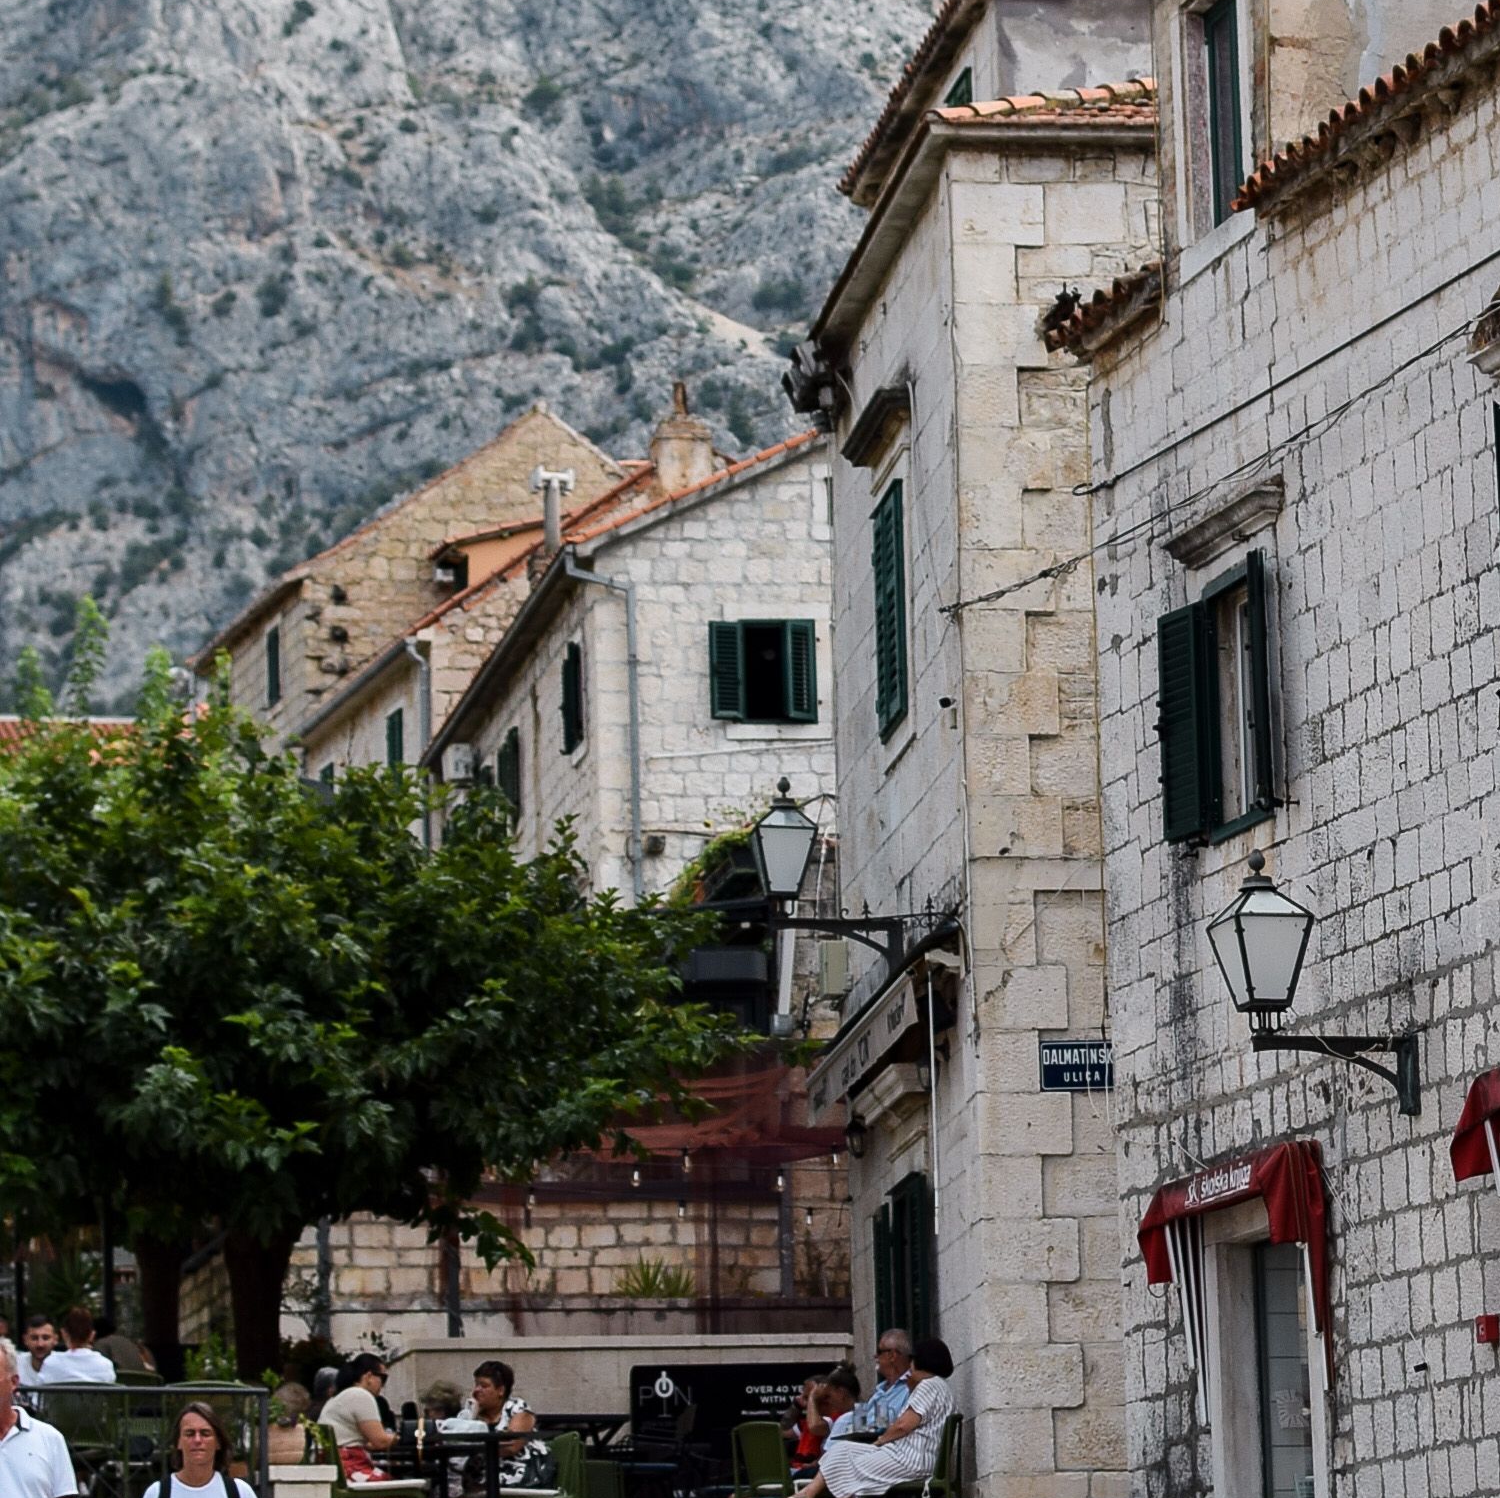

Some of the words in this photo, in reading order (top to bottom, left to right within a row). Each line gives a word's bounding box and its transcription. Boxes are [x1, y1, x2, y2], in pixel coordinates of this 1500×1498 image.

[1042, 1048, 1114, 1065] DALMATINSK
[1063, 1070, 1101, 1083] ULICA
[745, 1385, 773, 1394] OVER
[775, 1385, 789, 1393] 40
[760, 1395, 786, 1403] WITH
